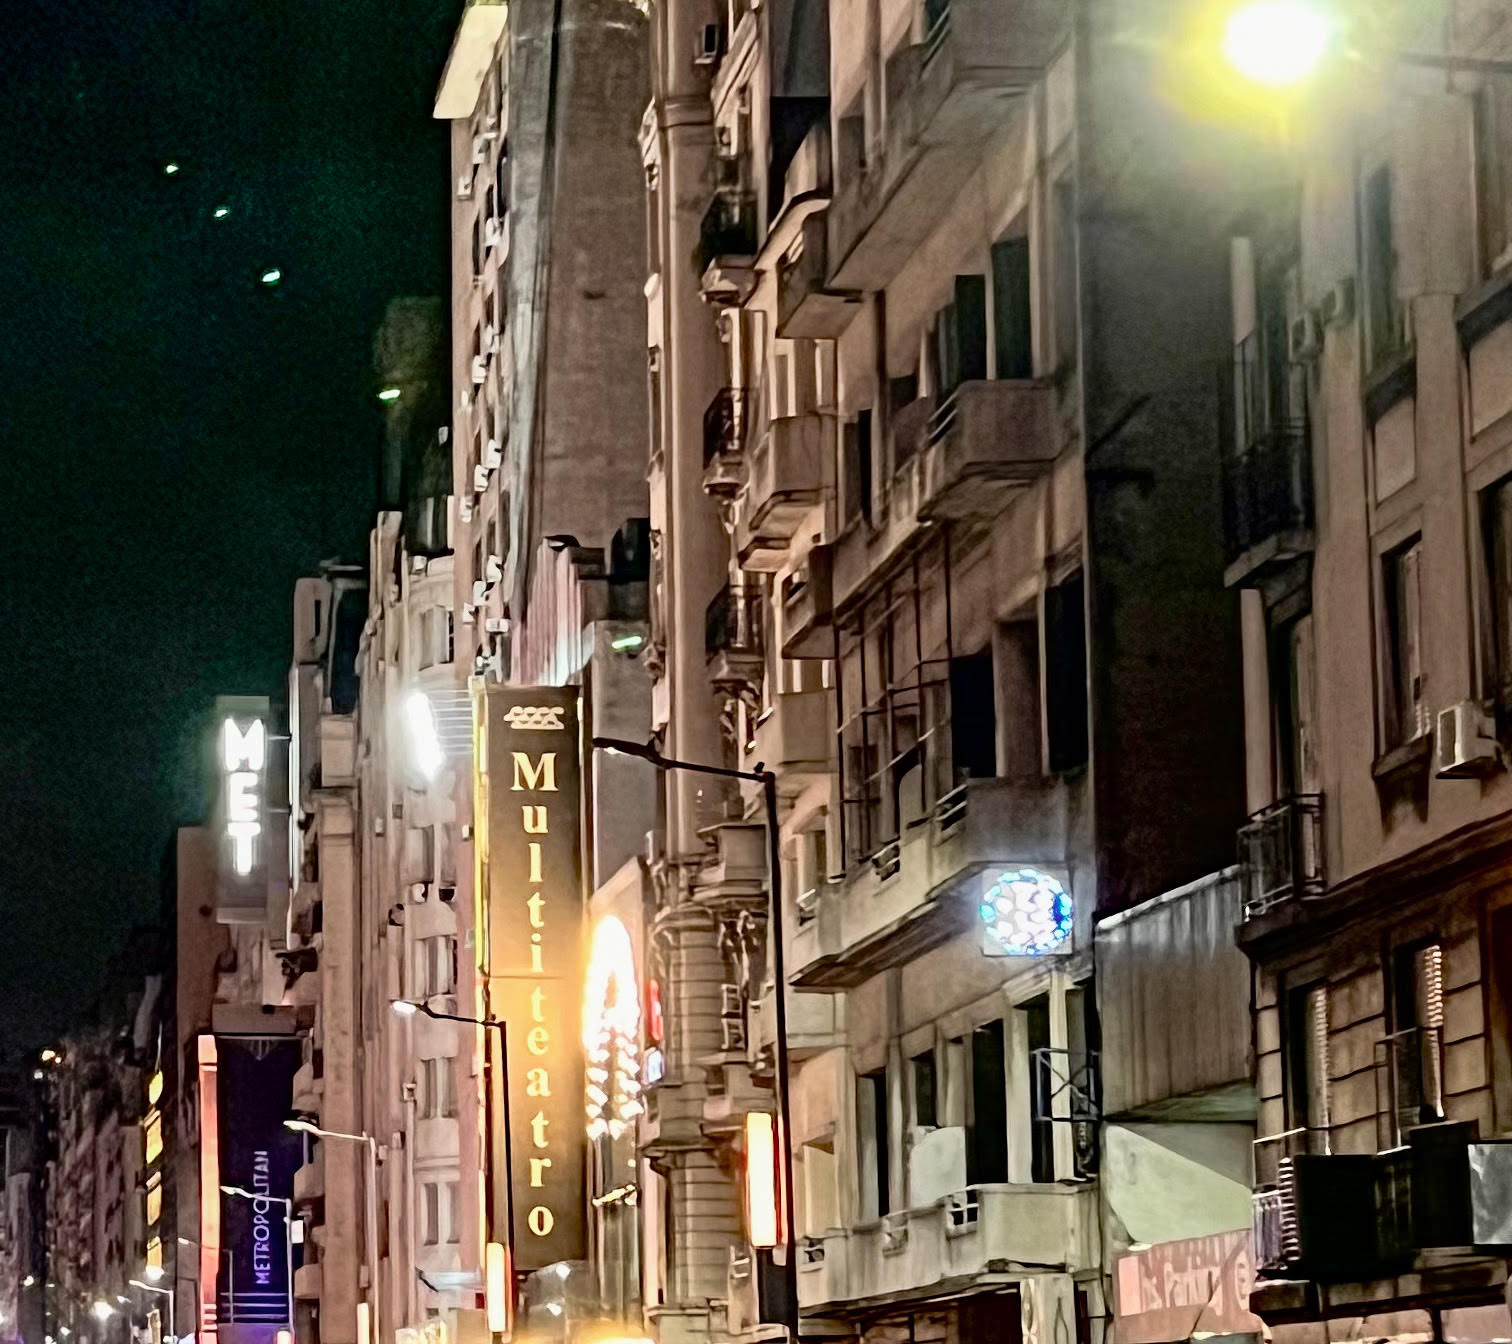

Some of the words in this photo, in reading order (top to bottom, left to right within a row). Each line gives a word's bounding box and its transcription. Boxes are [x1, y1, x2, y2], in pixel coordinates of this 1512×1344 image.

[224, 718, 264, 876] MET
[510, 752, 559, 1237] Multiteatro
[253, 1150, 271, 1285] METROPOLITAN
